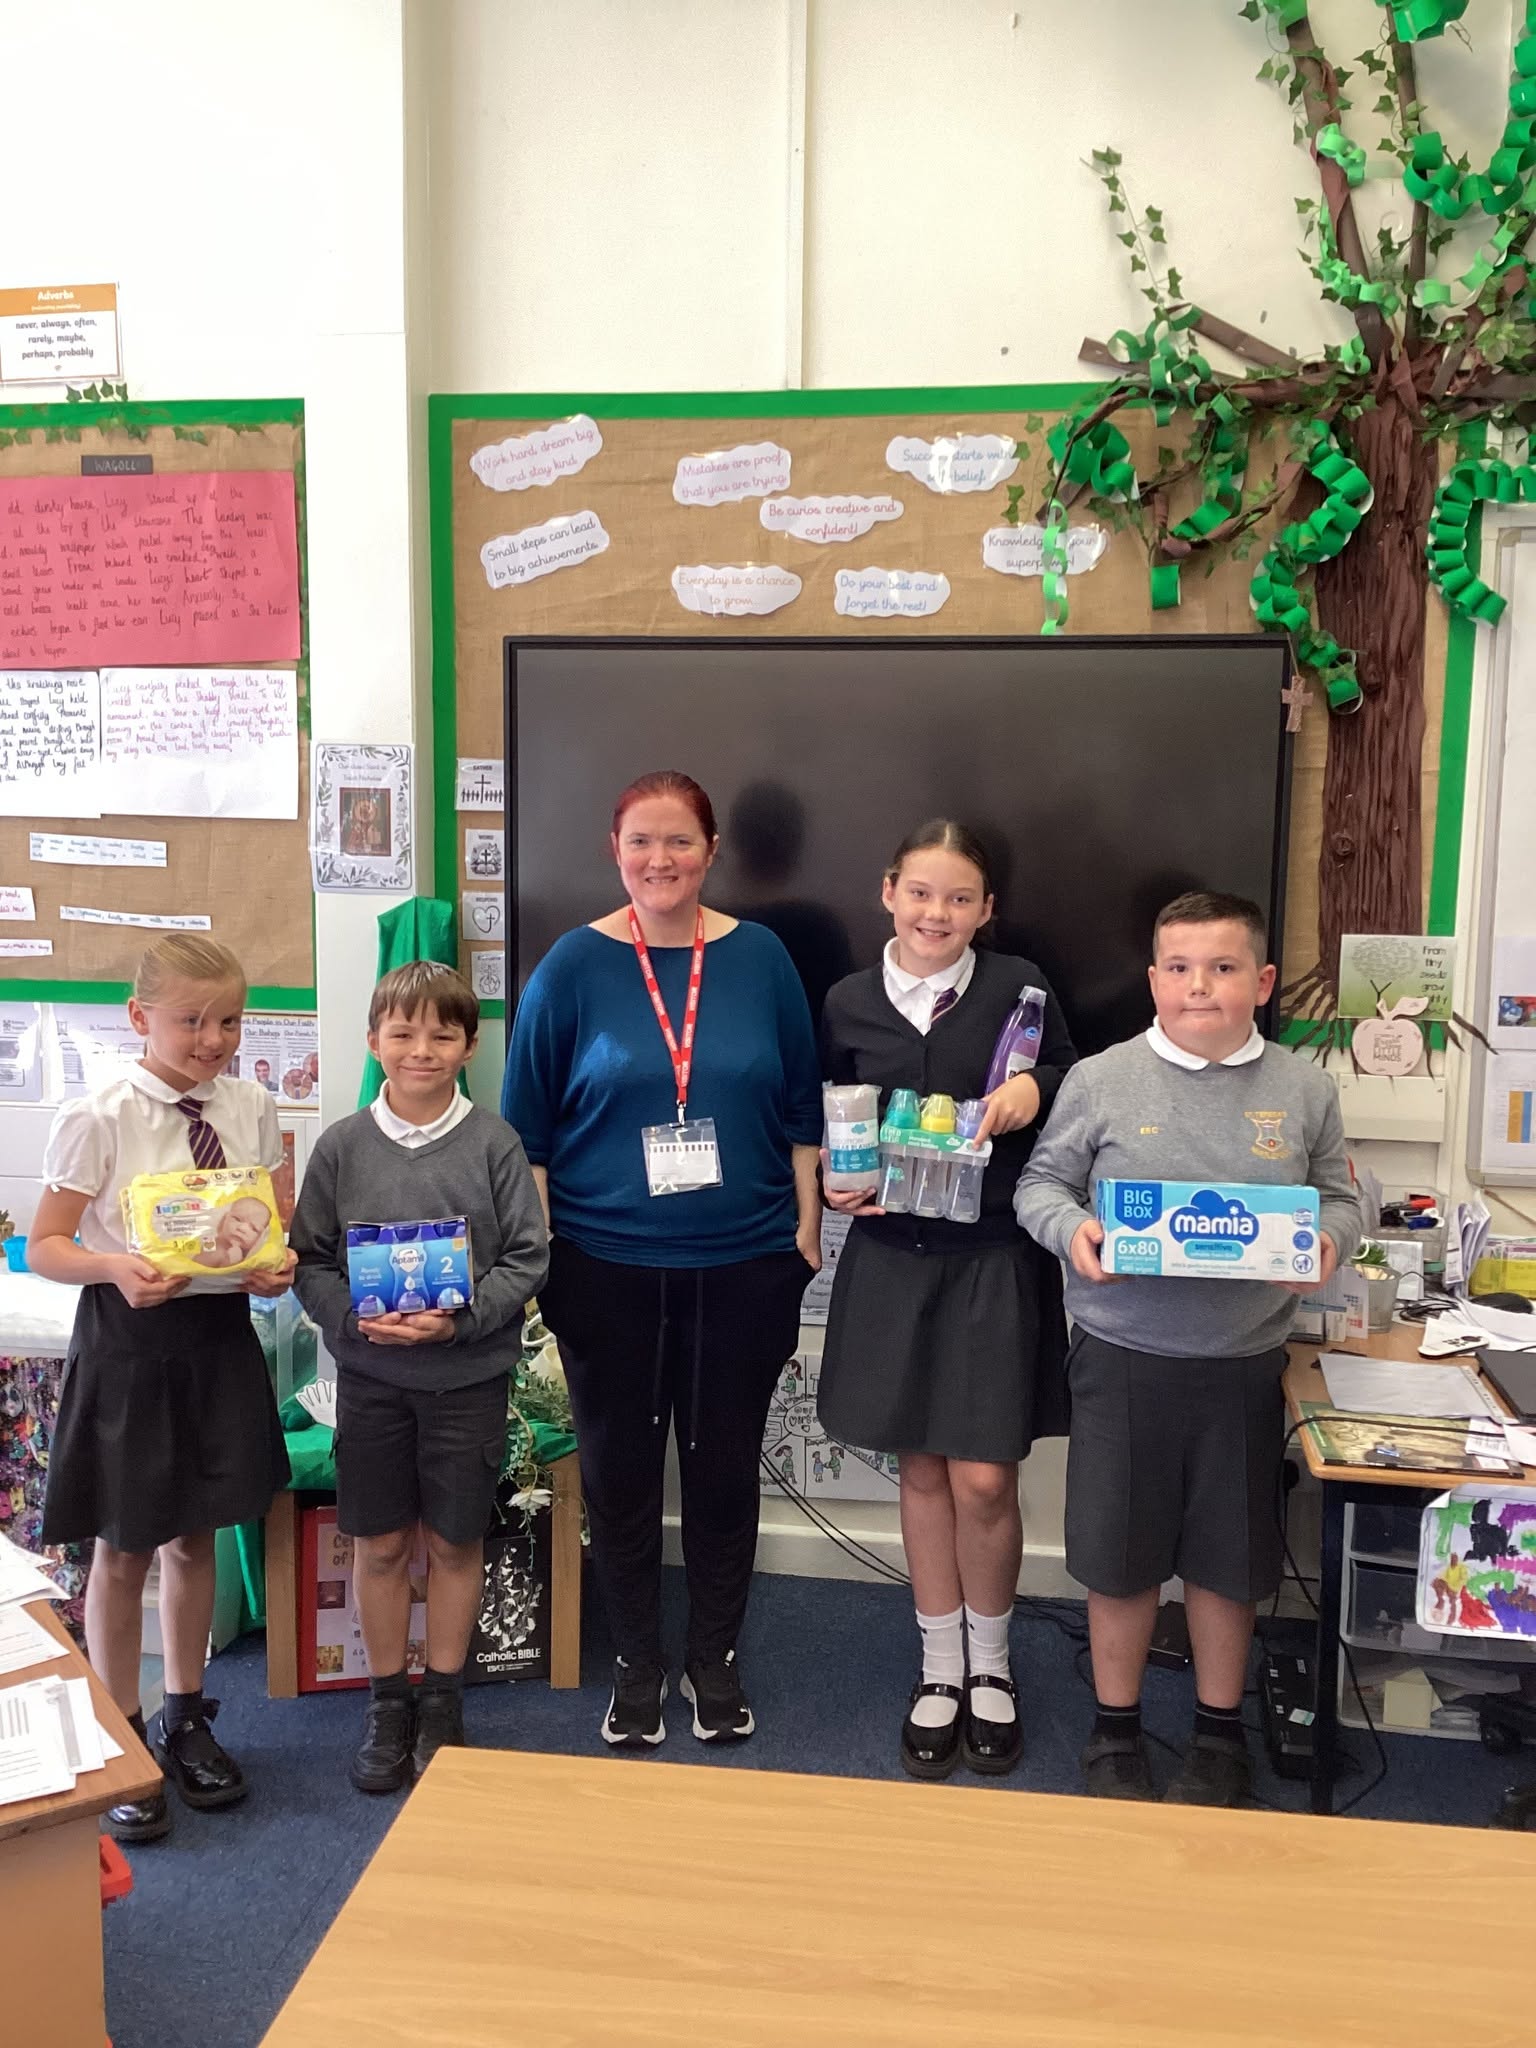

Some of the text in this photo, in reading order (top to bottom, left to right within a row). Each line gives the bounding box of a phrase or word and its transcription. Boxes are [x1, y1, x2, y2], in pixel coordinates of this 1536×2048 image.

[38, 290, 74, 300] Adverbs
[58, 347, 94, 359] probably
[478, 455, 507, 470] Work
[575, 430, 595, 442] big
[682, 450, 784, 477] Mistakes are proof
[506, 470, 526, 485] and
[529, 464, 552, 477] stay
[682, 487, 705, 498] that
[707, 484, 729, 498] you
[731, 481, 751, 490] are
[769, 503, 784, 517] Be
[825, 502, 870, 517] creative
[873, 500, 897, 513] and
[488, 518, 595, 561] Small steps can lead
[988, 534, 1043, 550] Knowledg
[494, 570, 507, 580] to
[507, 565, 525, 577] big
[679, 573, 728, 589] Everyday
[732, 576, 742, 585] is
[756, 575, 796, 586] chance
[840, 575, 937, 592] Do your best and
[710, 595, 721, 605] to
[845, 596, 880, 612] forget
[882, 600, 901, 610] the
[641, 953, 654, 979] VISITOR
[652, 991, 666, 1016] VISITOR
[689, 986, 698, 1012] VISITOR
[684, 1023, 693, 1048] VISITOR
[681, 1060, 689, 1087] VISITOR
[1124, 1190, 1153, 1205] BIG
[1124, 1206, 1153, 1218] BOX
[1175, 1208, 1253, 1236] mamia
[1118, 1240, 1159, 1256] 6x80
[392, 1254, 425, 1265] Aptamil
[441, 1256, 454, 1273] 2
[332, 1551, 348, 1566] of
[476, 1648, 541, 1663] Catholic BIBLE
